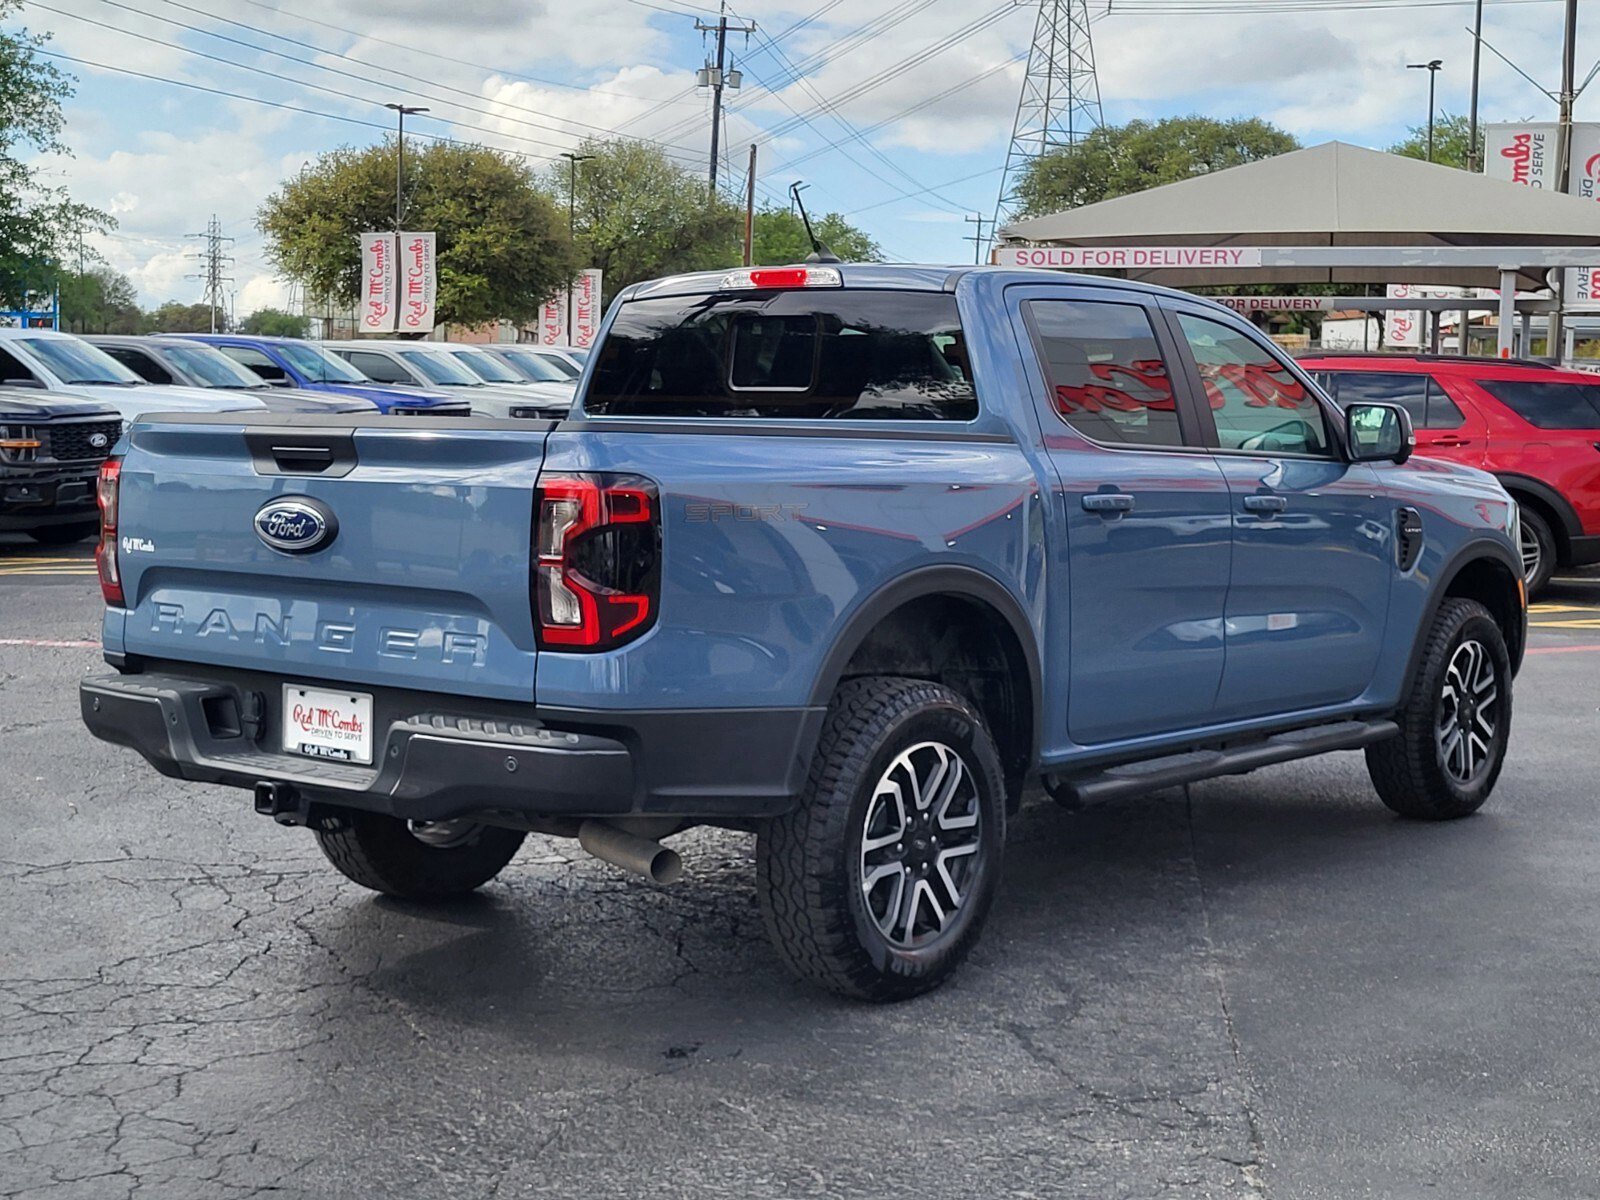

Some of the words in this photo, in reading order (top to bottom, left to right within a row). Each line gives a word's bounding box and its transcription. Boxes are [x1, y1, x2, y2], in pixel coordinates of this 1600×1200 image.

[1531, 133, 1545, 176] SERVE
[369, 238, 384, 299] McCombs
[408, 238, 424, 299] McCombs
[1015, 250, 1075, 266] SOLD
[1082, 250, 1126, 266] FOR
[1134, 249, 1243, 265] DELIVERY
[366, 300, 388, 327] Red
[405, 300, 428, 327] Red
[1250, 298, 1322, 309] DELIVERY
[267, 511, 307, 538] Ford
[684, 503, 809, 523] SPORT
[151, 601, 488, 668] RANGER
[293, 703, 314, 732] Red
[315, 707, 363, 733] McCombs
[310, 727, 333, 738] DRIVEN
[334, 731, 343, 739] TO
[344, 733, 362, 742] SERVE
